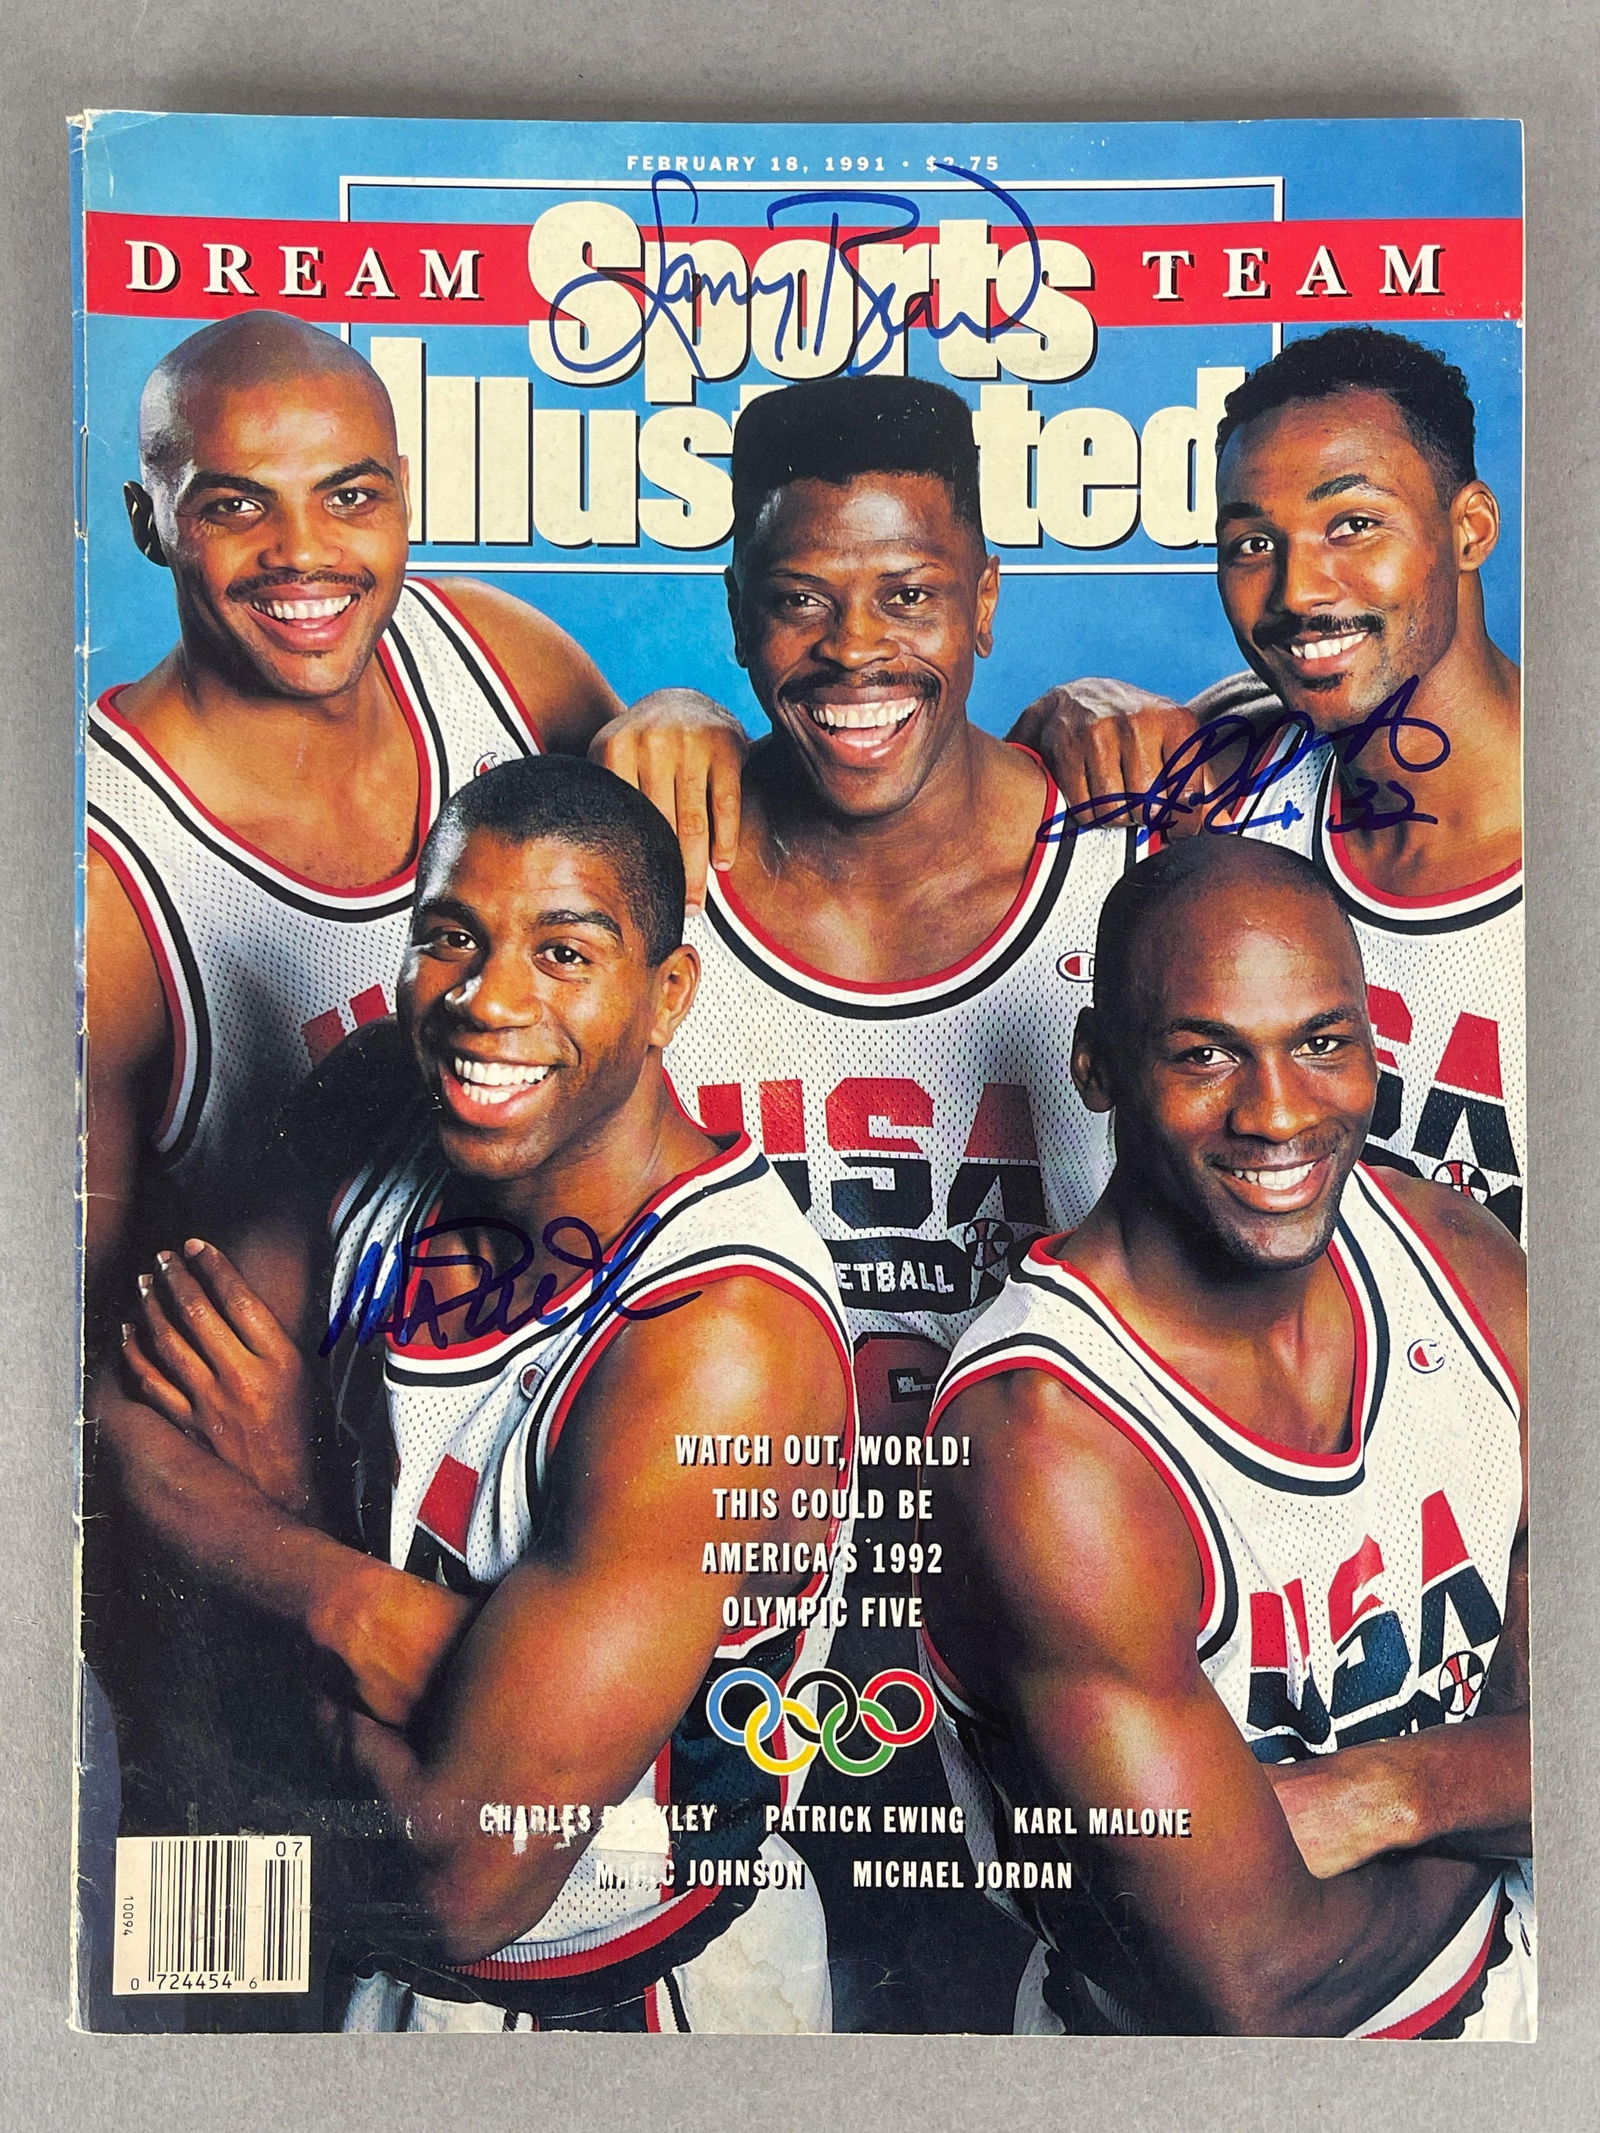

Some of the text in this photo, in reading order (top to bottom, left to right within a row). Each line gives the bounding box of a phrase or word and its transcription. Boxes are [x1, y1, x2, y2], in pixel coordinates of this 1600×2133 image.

[626, 155, 756, 172] FEBRUARY
[770, 155, 809, 175] 18,
[825, 155, 886, 172] 1991
[124, 239, 486, 301] DREAM
[1141, 244, 1447, 302] TEAM
[527, 201, 1096, 405] Sports
[370, 336, 1247, 550] Illusted
[674, 1434, 972, 1471] WATCH OUT, WORLD!
[712, 1488, 934, 1520] THIS COULD BE
[701, 1541, 943, 1575] AMERICA'S 1992
[721, 1595, 924, 1629] OLYMPIC FIVE
[764, 1805, 873, 1834] PATRICK
[883, 1806, 966, 1834] EWING
[1013, 1806, 1078, 1835] KARL
[1088, 1808, 1192, 1838] MALONE
[275, 1841, 304, 1857] 07
[686, 1858, 807, 1890] JOHNSON
[852, 1859, 965, 1889] MICHAEL
[974, 1860, 1073, 1890] JORDAN
[122, 1895, 135, 1936] 10094
[156, 1973, 233, 1990] 724454
